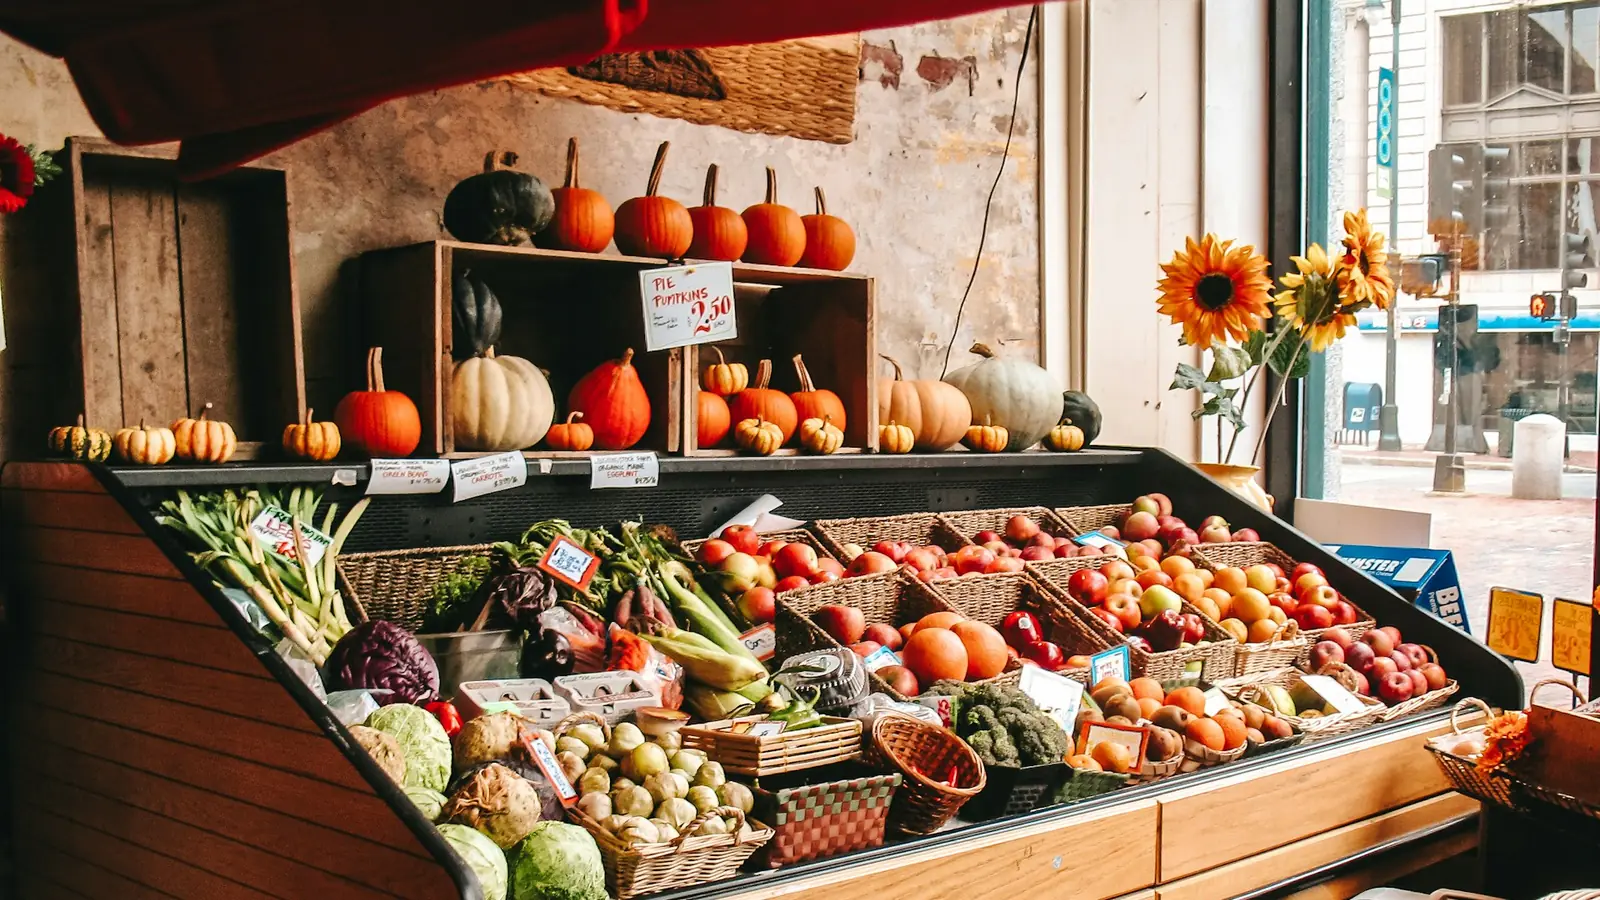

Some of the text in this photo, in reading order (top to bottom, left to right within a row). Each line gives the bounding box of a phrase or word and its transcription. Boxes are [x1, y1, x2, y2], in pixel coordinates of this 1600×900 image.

[652, 276, 676, 291] PIE
[652, 287, 708, 307] PUMPKINS
[607, 471, 639, 479] EGGPLANT
[265, 517, 313, 550] LEES
